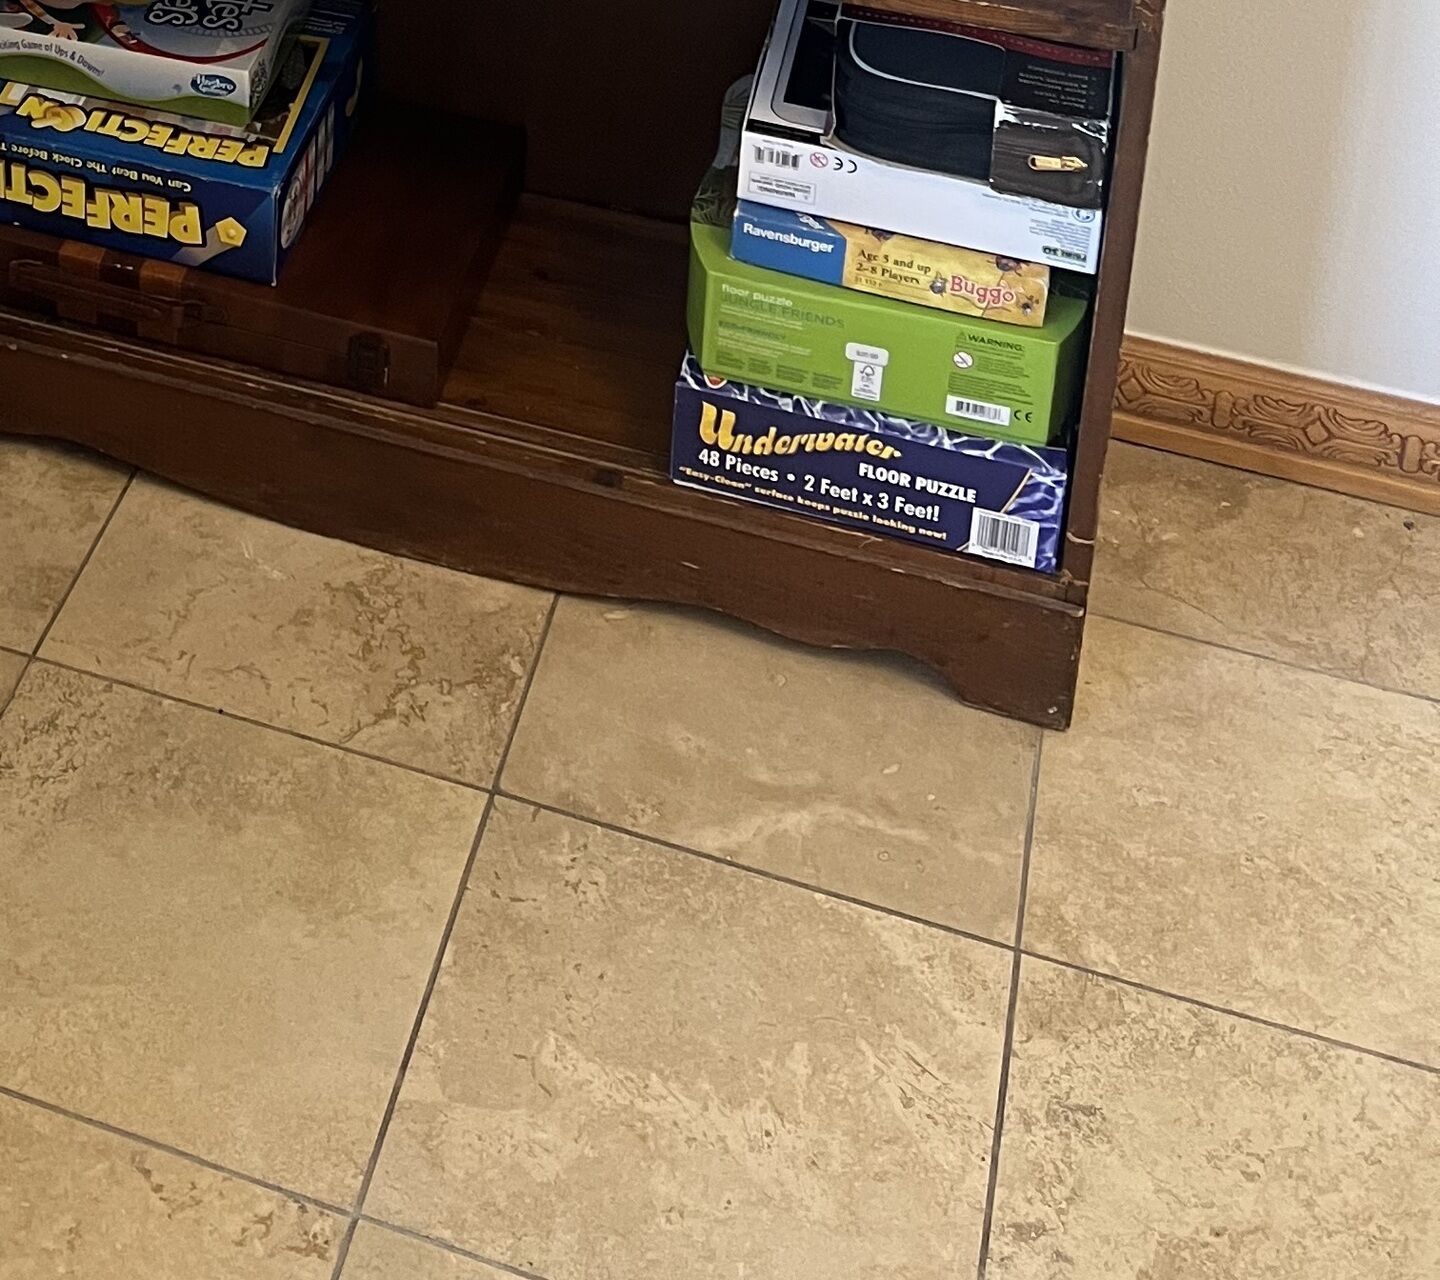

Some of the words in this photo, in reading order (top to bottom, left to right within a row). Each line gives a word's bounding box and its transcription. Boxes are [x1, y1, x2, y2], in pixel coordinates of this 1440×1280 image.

[21, 40, 43, 52] Game
[44, 43, 53, 52] of
[54, 45, 69, 60] Ups
[69, 51, 77, 61] &
[77, 56, 106, 78] Downs!
[15, 95, 271, 169] PERFECTION
[11, 144, 48, 162] Before
[52, 153, 82, 168] Clock
[86, 161, 107, 174] The
[111, 167, 139, 182] Beat
[142, 171, 163, 185] You
[167, 179, 191, 192] Can
[743, 223, 834, 254] Ravensburger
[856, 263, 878, 275] 2-8
[881, 268, 920, 285] Players
[858, 249, 879, 264] Age
[881, 255, 889, 265] 5
[893, 258, 913, 269] and
[916, 264, 931, 276] up
[722, 285, 750, 298] floor
[753, 292, 793, 308] puzzle
[950, 276, 1016, 306] Buggo
[721, 295, 776, 318] JUNGLE
[781, 307, 845, 329] FRIENDS
[699, 401, 902, 459] Underwater
[698, 450, 720, 468] 48
[725, 455, 779, 482] Pieces
[804, 474, 815, 491] 2
[820, 478, 858, 503] Feet
[862, 492, 872, 506] x
[877, 492, 889, 509] 3
[894, 497, 940, 522] Feet!
[859, 462, 911, 489] FLOOR
[915, 477, 977, 504] PUZZLE
[754, 487, 794, 502] surface
[796, 495, 831, 513] keeps
[832, 505, 870, 523] puzzle
[872, 513, 915, 534] looking
[919, 524, 947, 541] new!
